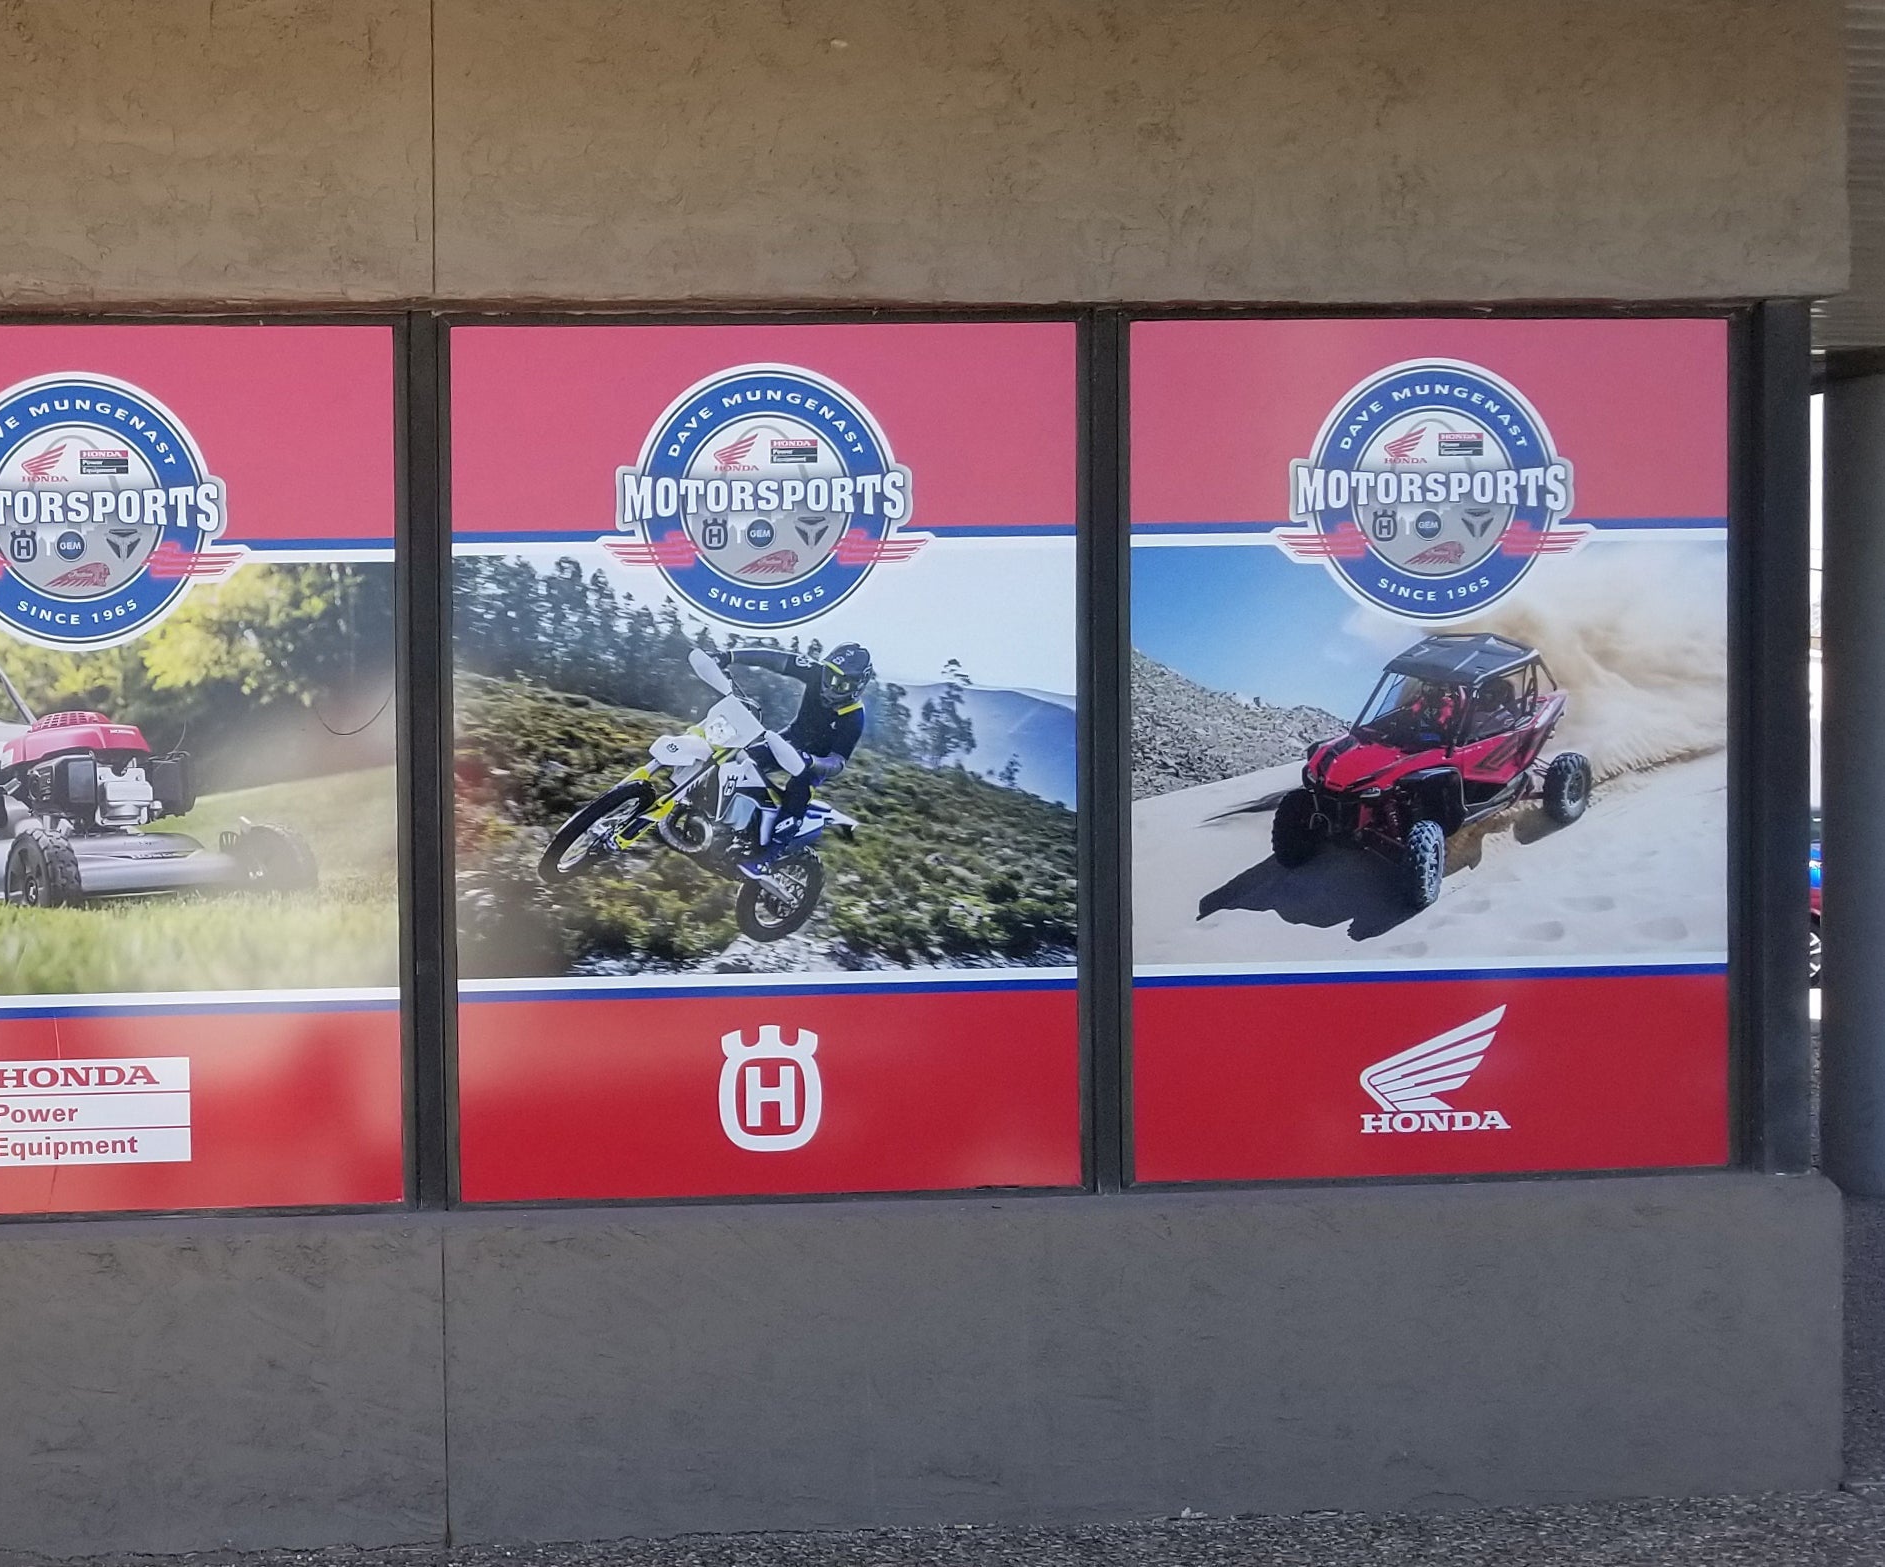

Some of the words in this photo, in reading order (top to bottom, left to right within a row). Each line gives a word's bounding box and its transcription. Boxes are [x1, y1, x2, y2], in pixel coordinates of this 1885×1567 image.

[668, 407, 713, 457] DAVE
[722, 389, 864, 456] MUNGENAST
[1340, 401, 1383, 450] DAVE
[1391, 384, 1528, 448] MUNGENAST
[28, 399, 176, 466] MUNGENAST
[622, 470, 905, 523] MOTORSPORTS
[1297, 464, 1565, 515] MOTORSPORTS
[749, 529, 771, 538] GEM
[1418, 521, 1439, 529] GEM
[59, 541, 82, 550] GEM
[708, 587, 770, 611] SINCE
[779, 585, 825, 610] 1965
[1378, 577, 1437, 601] SINCE
[1447, 576, 1490, 600] 1965
[17, 600, 81, 625] SINCE
[91, 599, 138, 624] 1965
[1360, 1110, 1512, 1134] HONDA
